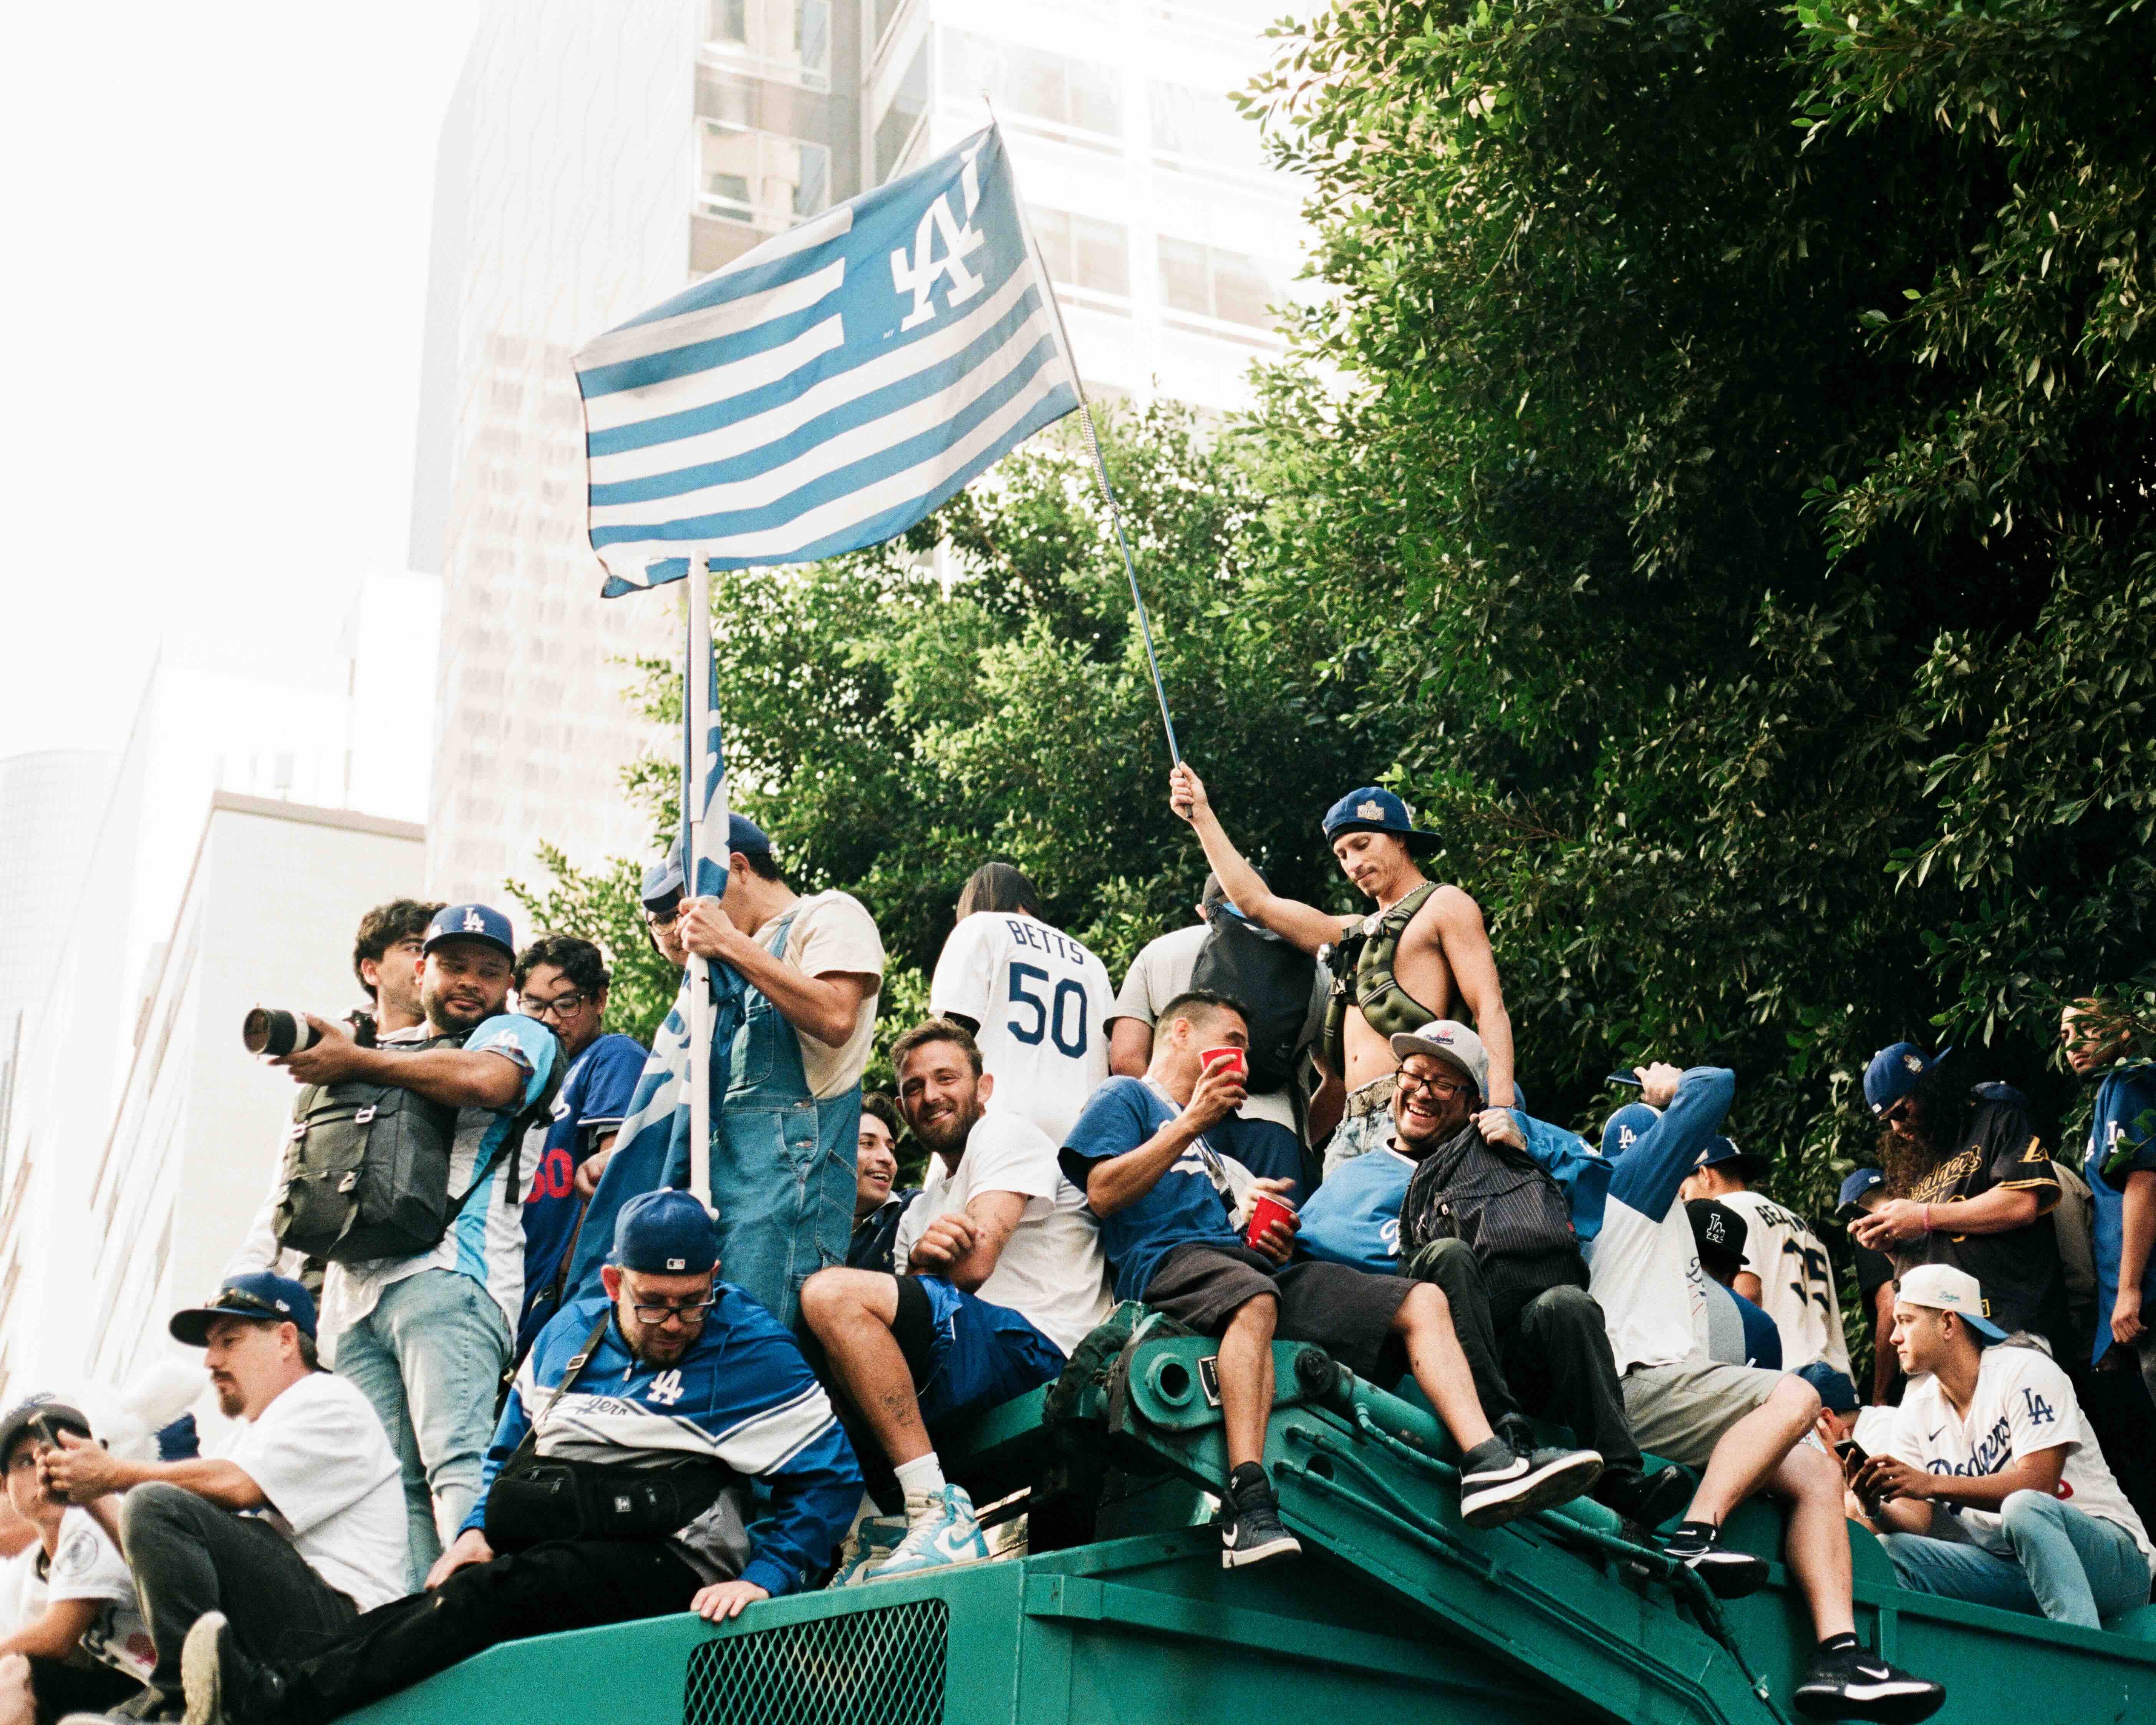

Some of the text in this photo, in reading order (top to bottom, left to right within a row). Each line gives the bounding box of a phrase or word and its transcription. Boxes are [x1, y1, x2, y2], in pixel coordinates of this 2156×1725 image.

[463, 907, 484, 932] LA
[1005, 920, 1084, 965] BETTS
[1007, 962, 1088, 1059] 50
[1618, 1125, 1637, 1149] LA
[1706, 1213, 1725, 1243] LA
[646, 1368, 684, 1406] LA
[2025, 1388, 2055, 1425] LA
